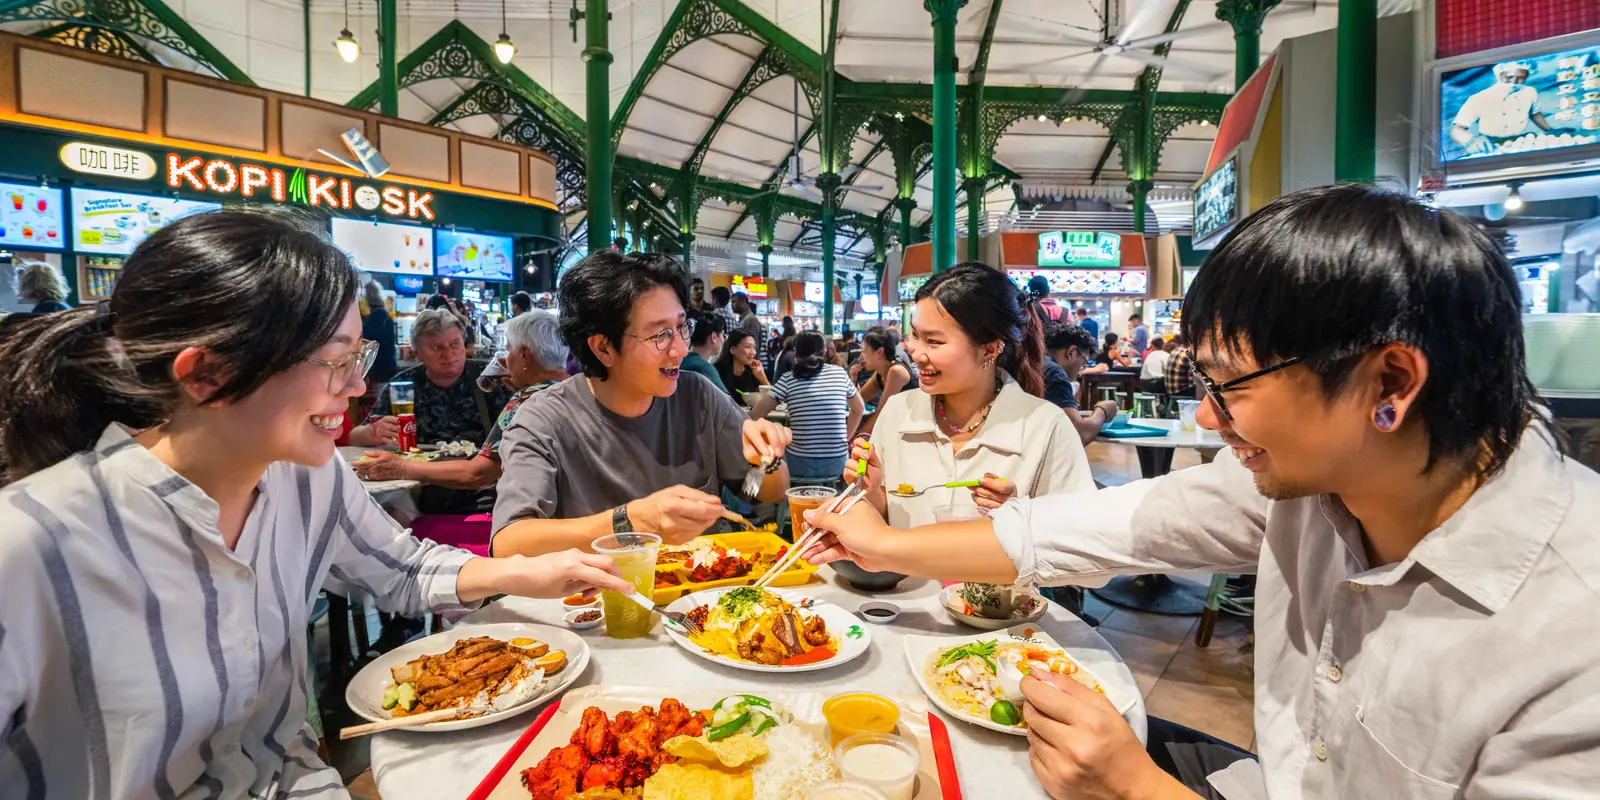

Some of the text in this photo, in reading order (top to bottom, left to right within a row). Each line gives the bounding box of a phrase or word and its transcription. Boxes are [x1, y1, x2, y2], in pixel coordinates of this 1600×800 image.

[80, 148, 140, 174] 咖啡
[167, 153, 435, 221] KOPI KIOSK
